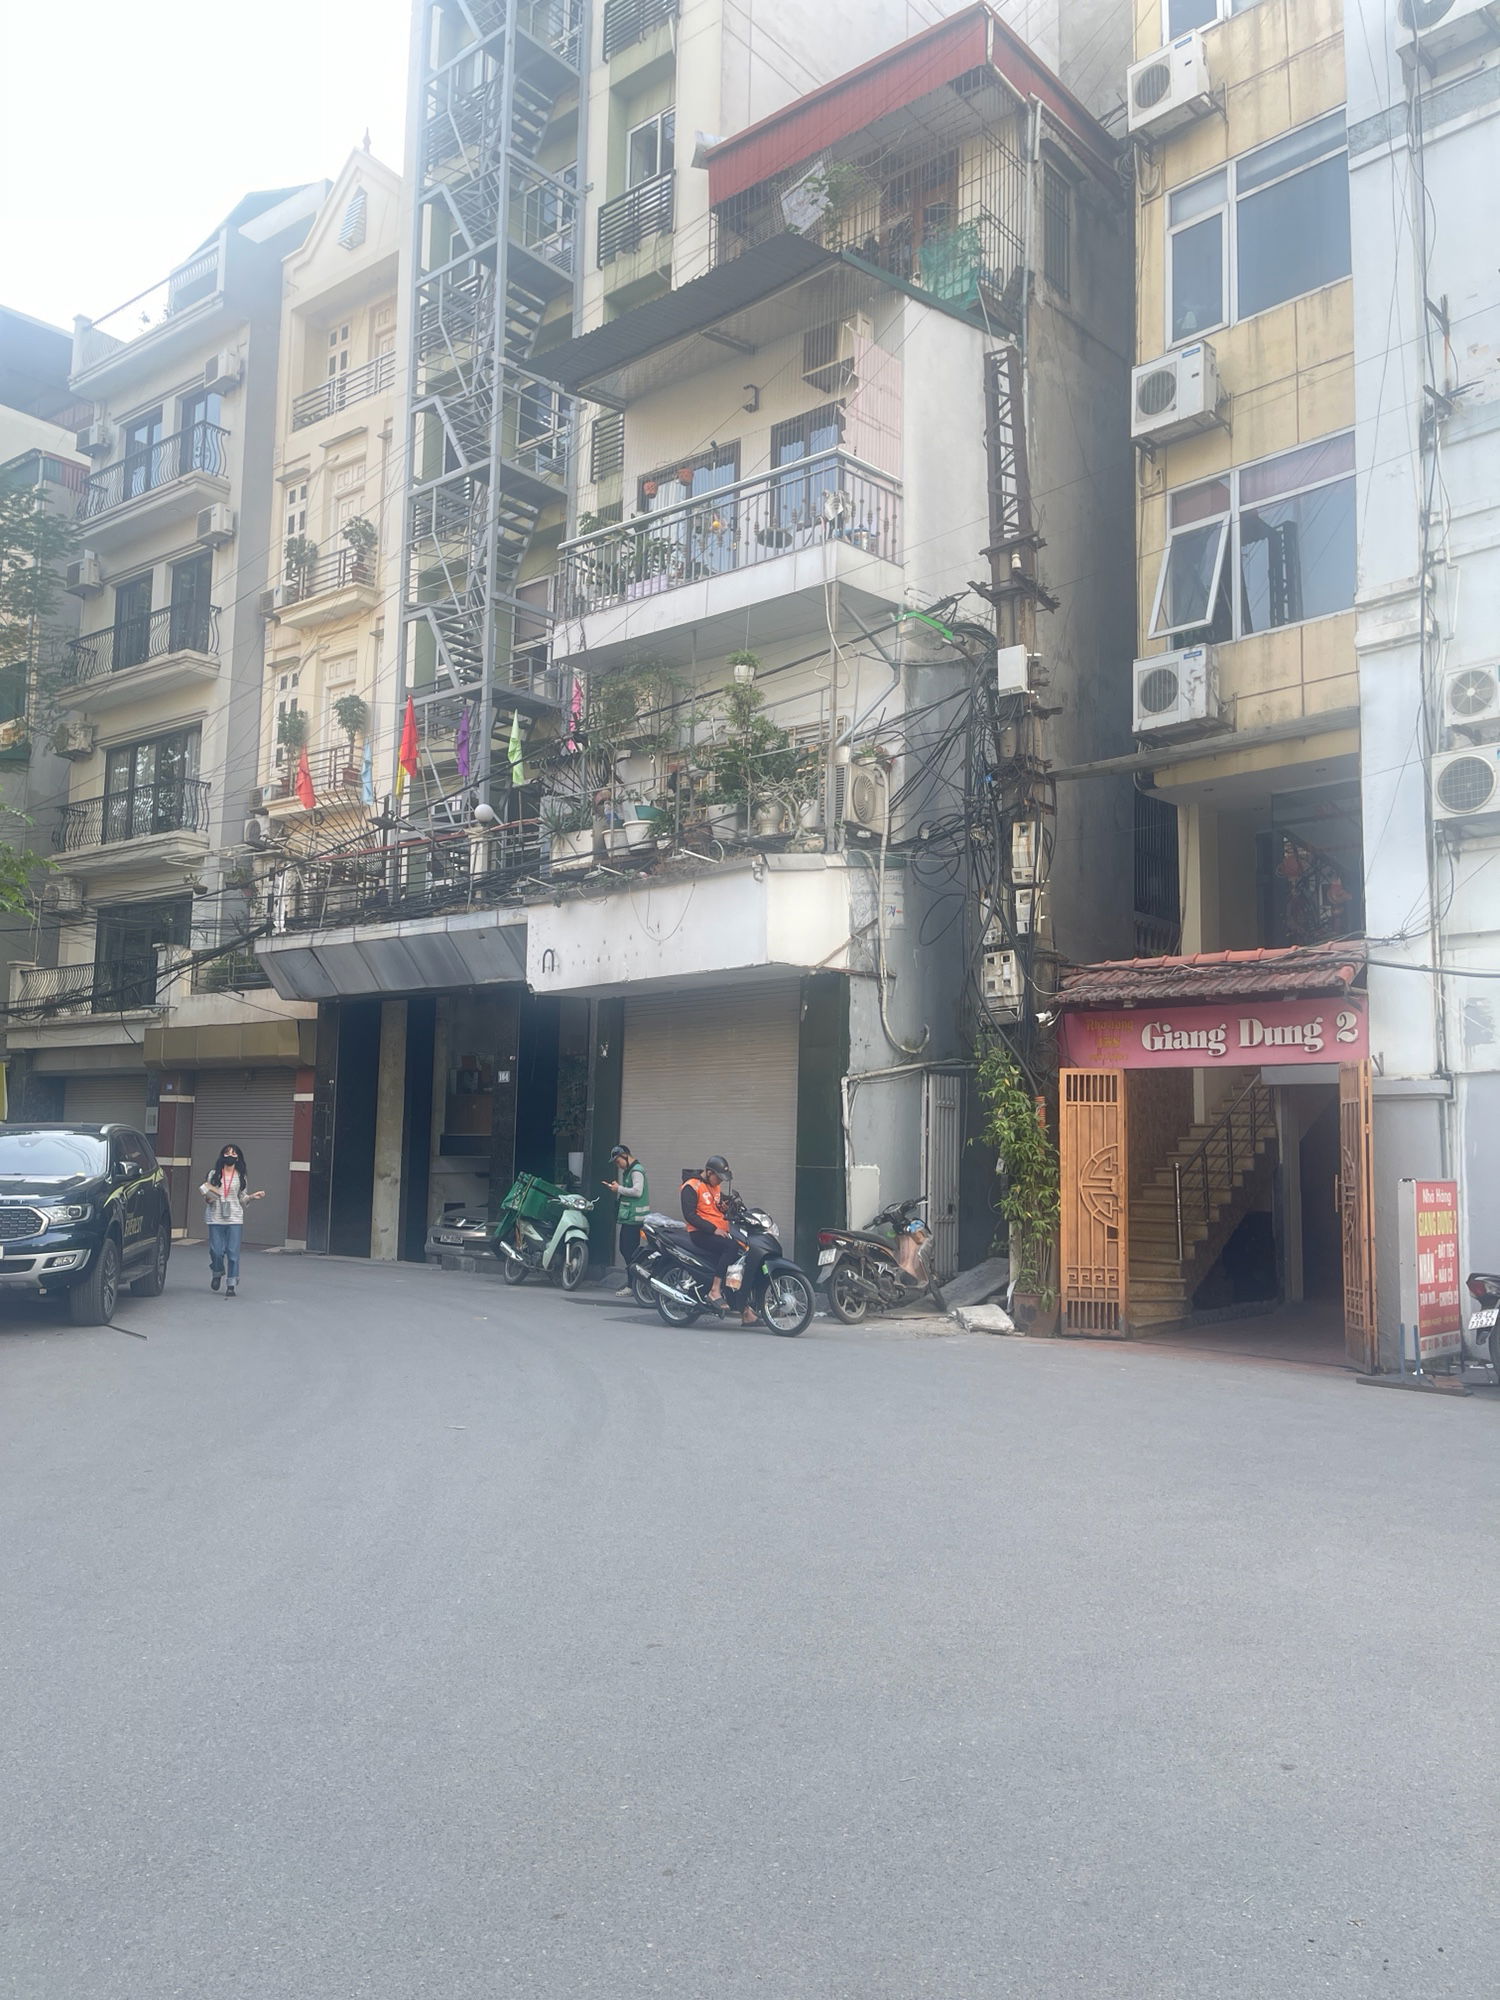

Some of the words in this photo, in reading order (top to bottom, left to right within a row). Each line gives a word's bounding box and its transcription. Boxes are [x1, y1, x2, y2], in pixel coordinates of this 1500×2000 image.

[1141, 1021, 1227, 1056] Giang
[1238, 1017, 1324, 1053] Dung
[1336, 1011, 1358, 1043] 2
